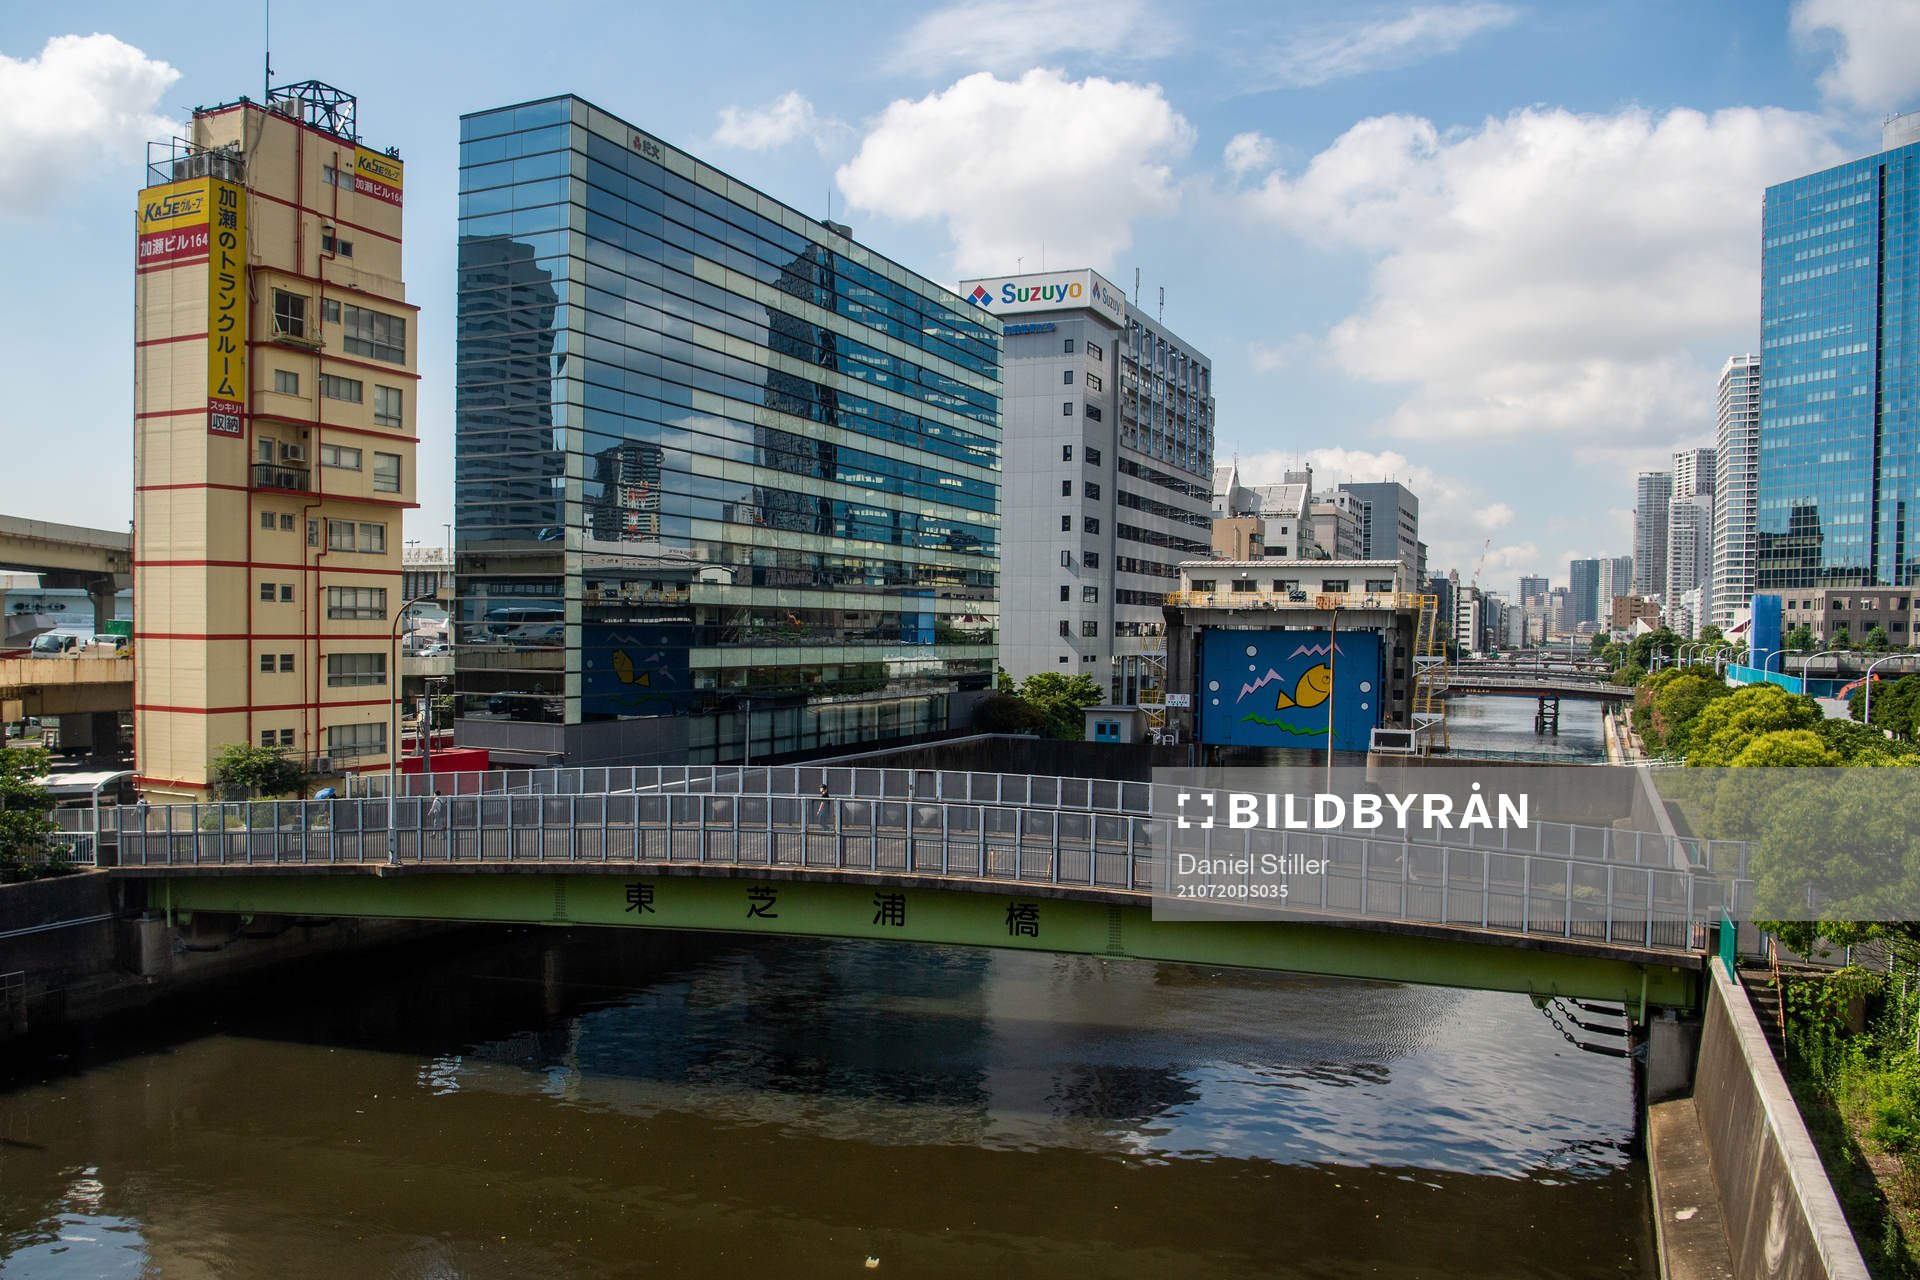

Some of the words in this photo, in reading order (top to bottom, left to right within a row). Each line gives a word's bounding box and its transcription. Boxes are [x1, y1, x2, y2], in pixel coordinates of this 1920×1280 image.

[140, 232, 209, 257] 加瀬ビル164
[216, 185, 238, 397] 加瀬のトランクルーム
[1001, 282, 1083, 304] Suzuyo
